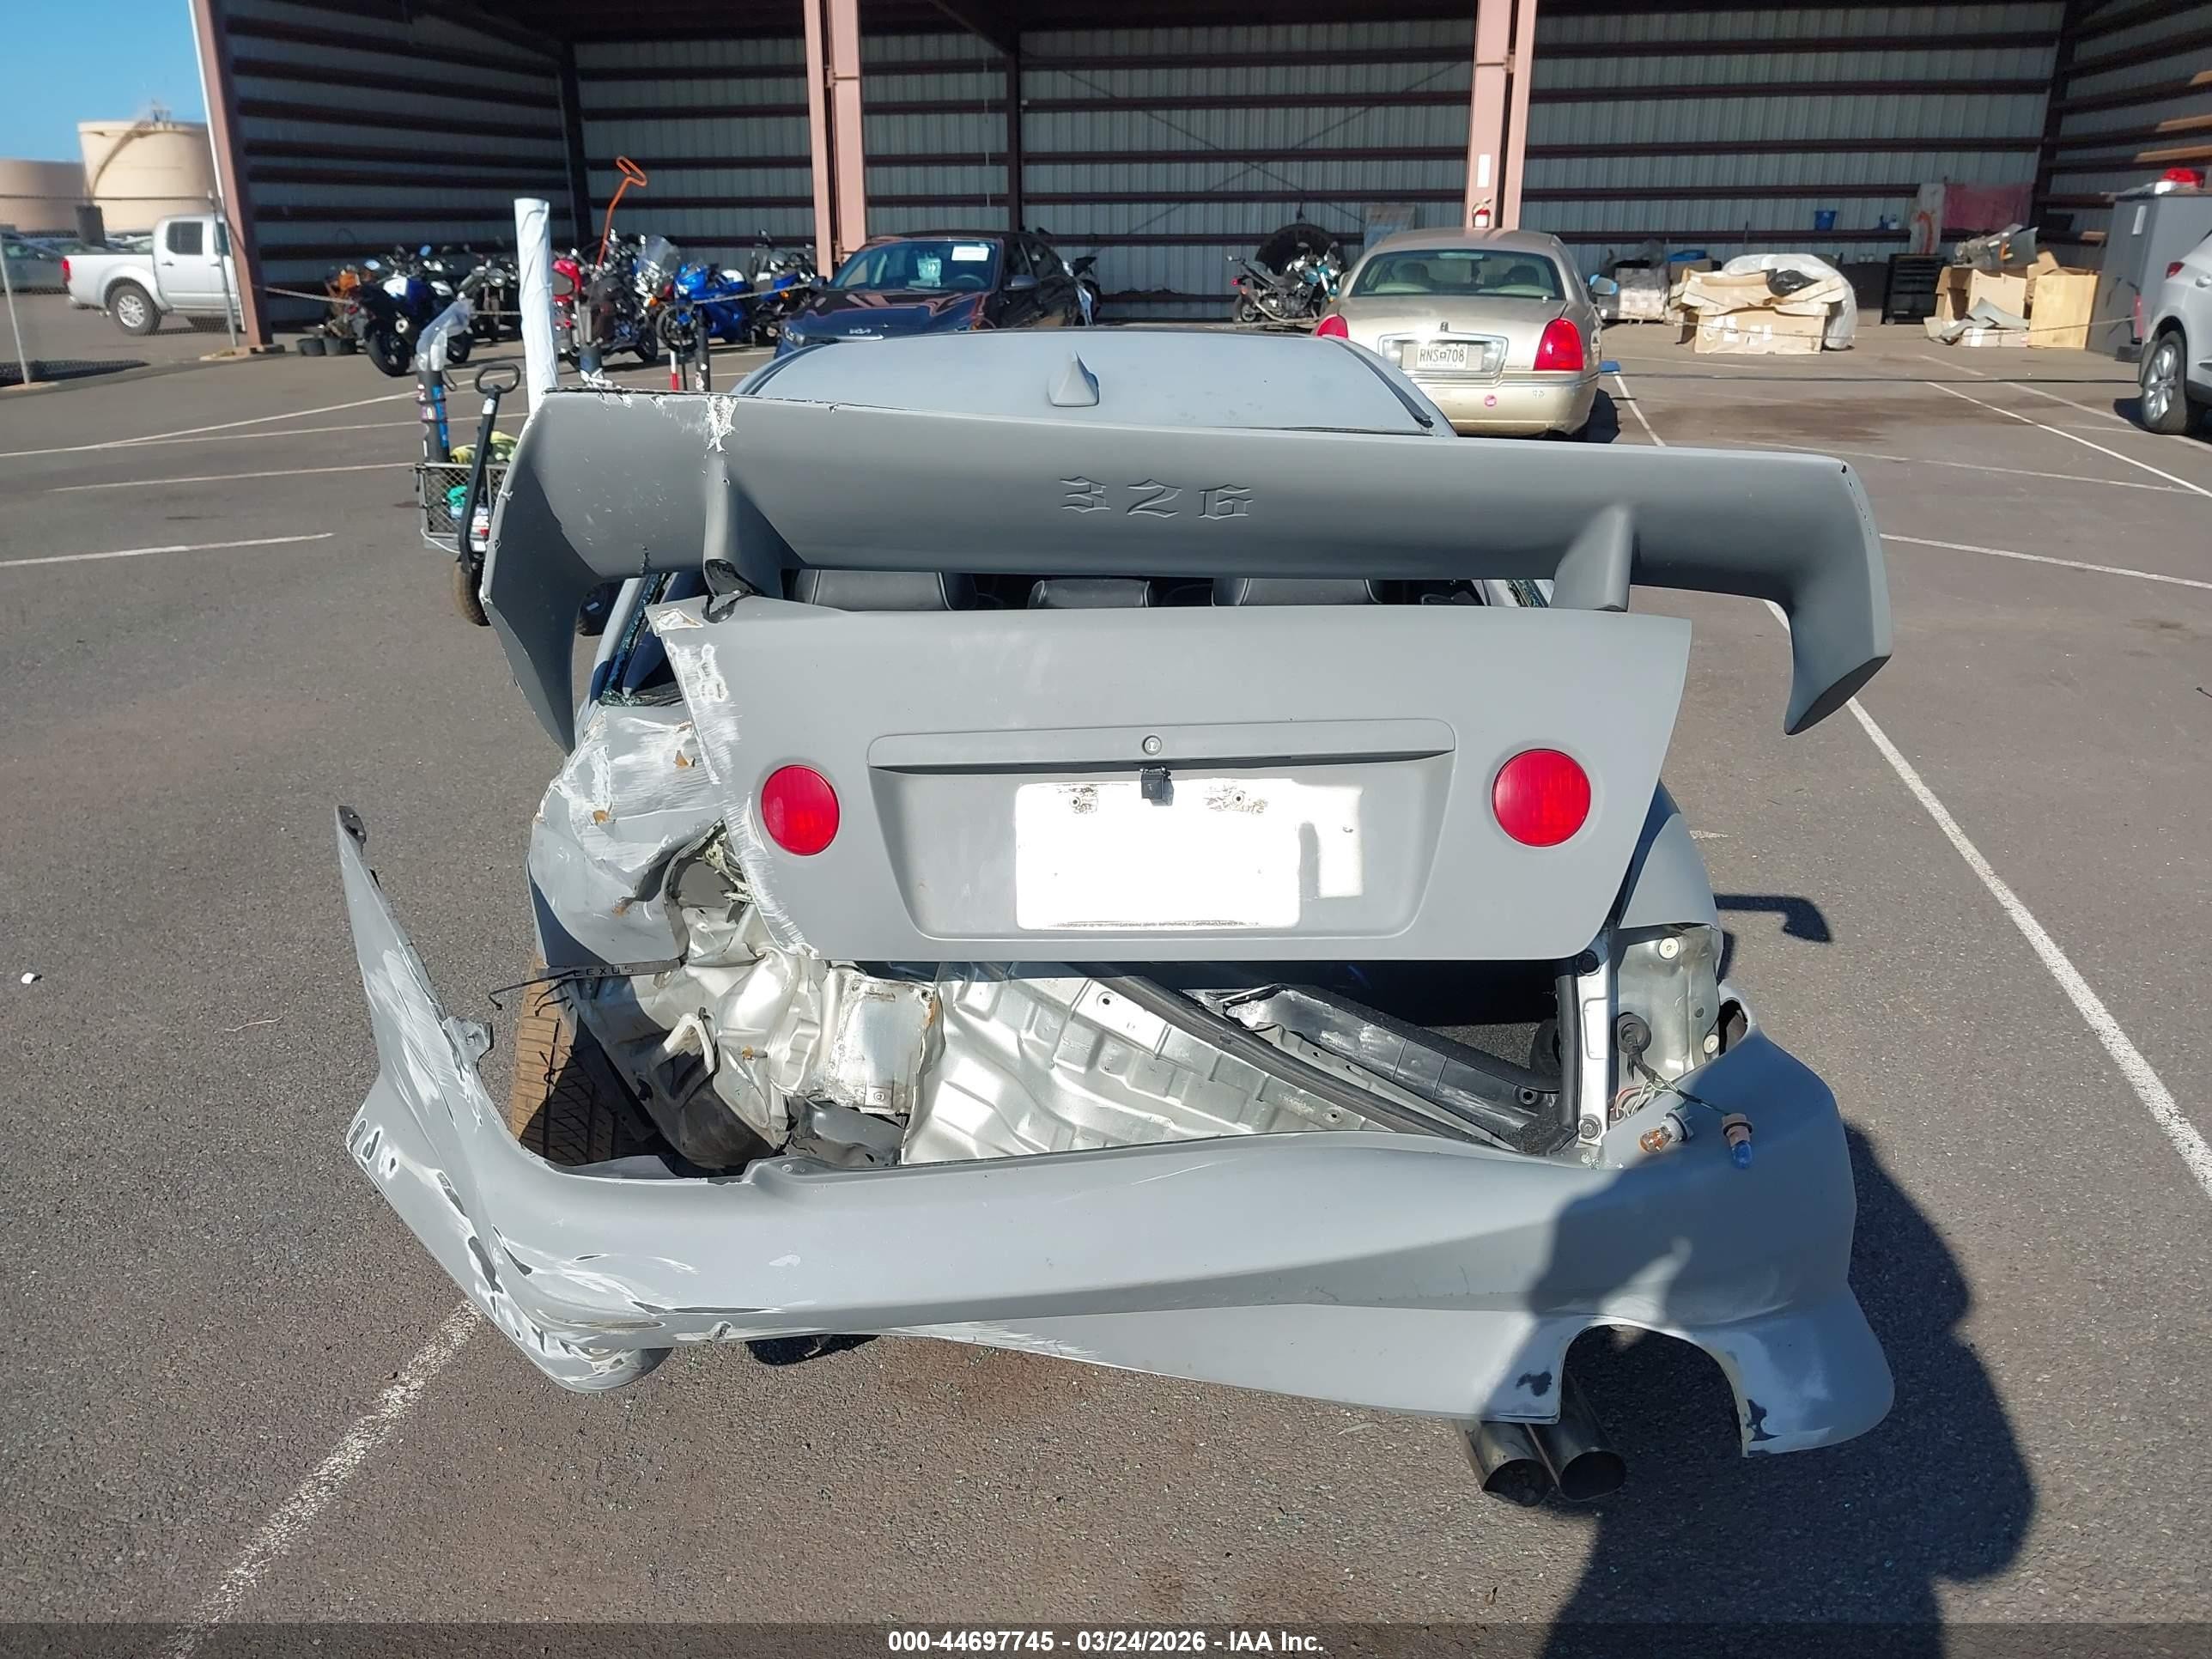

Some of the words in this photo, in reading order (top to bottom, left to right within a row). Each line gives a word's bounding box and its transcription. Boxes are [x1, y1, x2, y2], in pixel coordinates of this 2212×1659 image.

[1419, 348, 1439, 362] RNS
[1446, 348, 1465, 362] 708
[1058, 476, 1255, 520] 326
[574, 965, 634, 977] LEXUS
